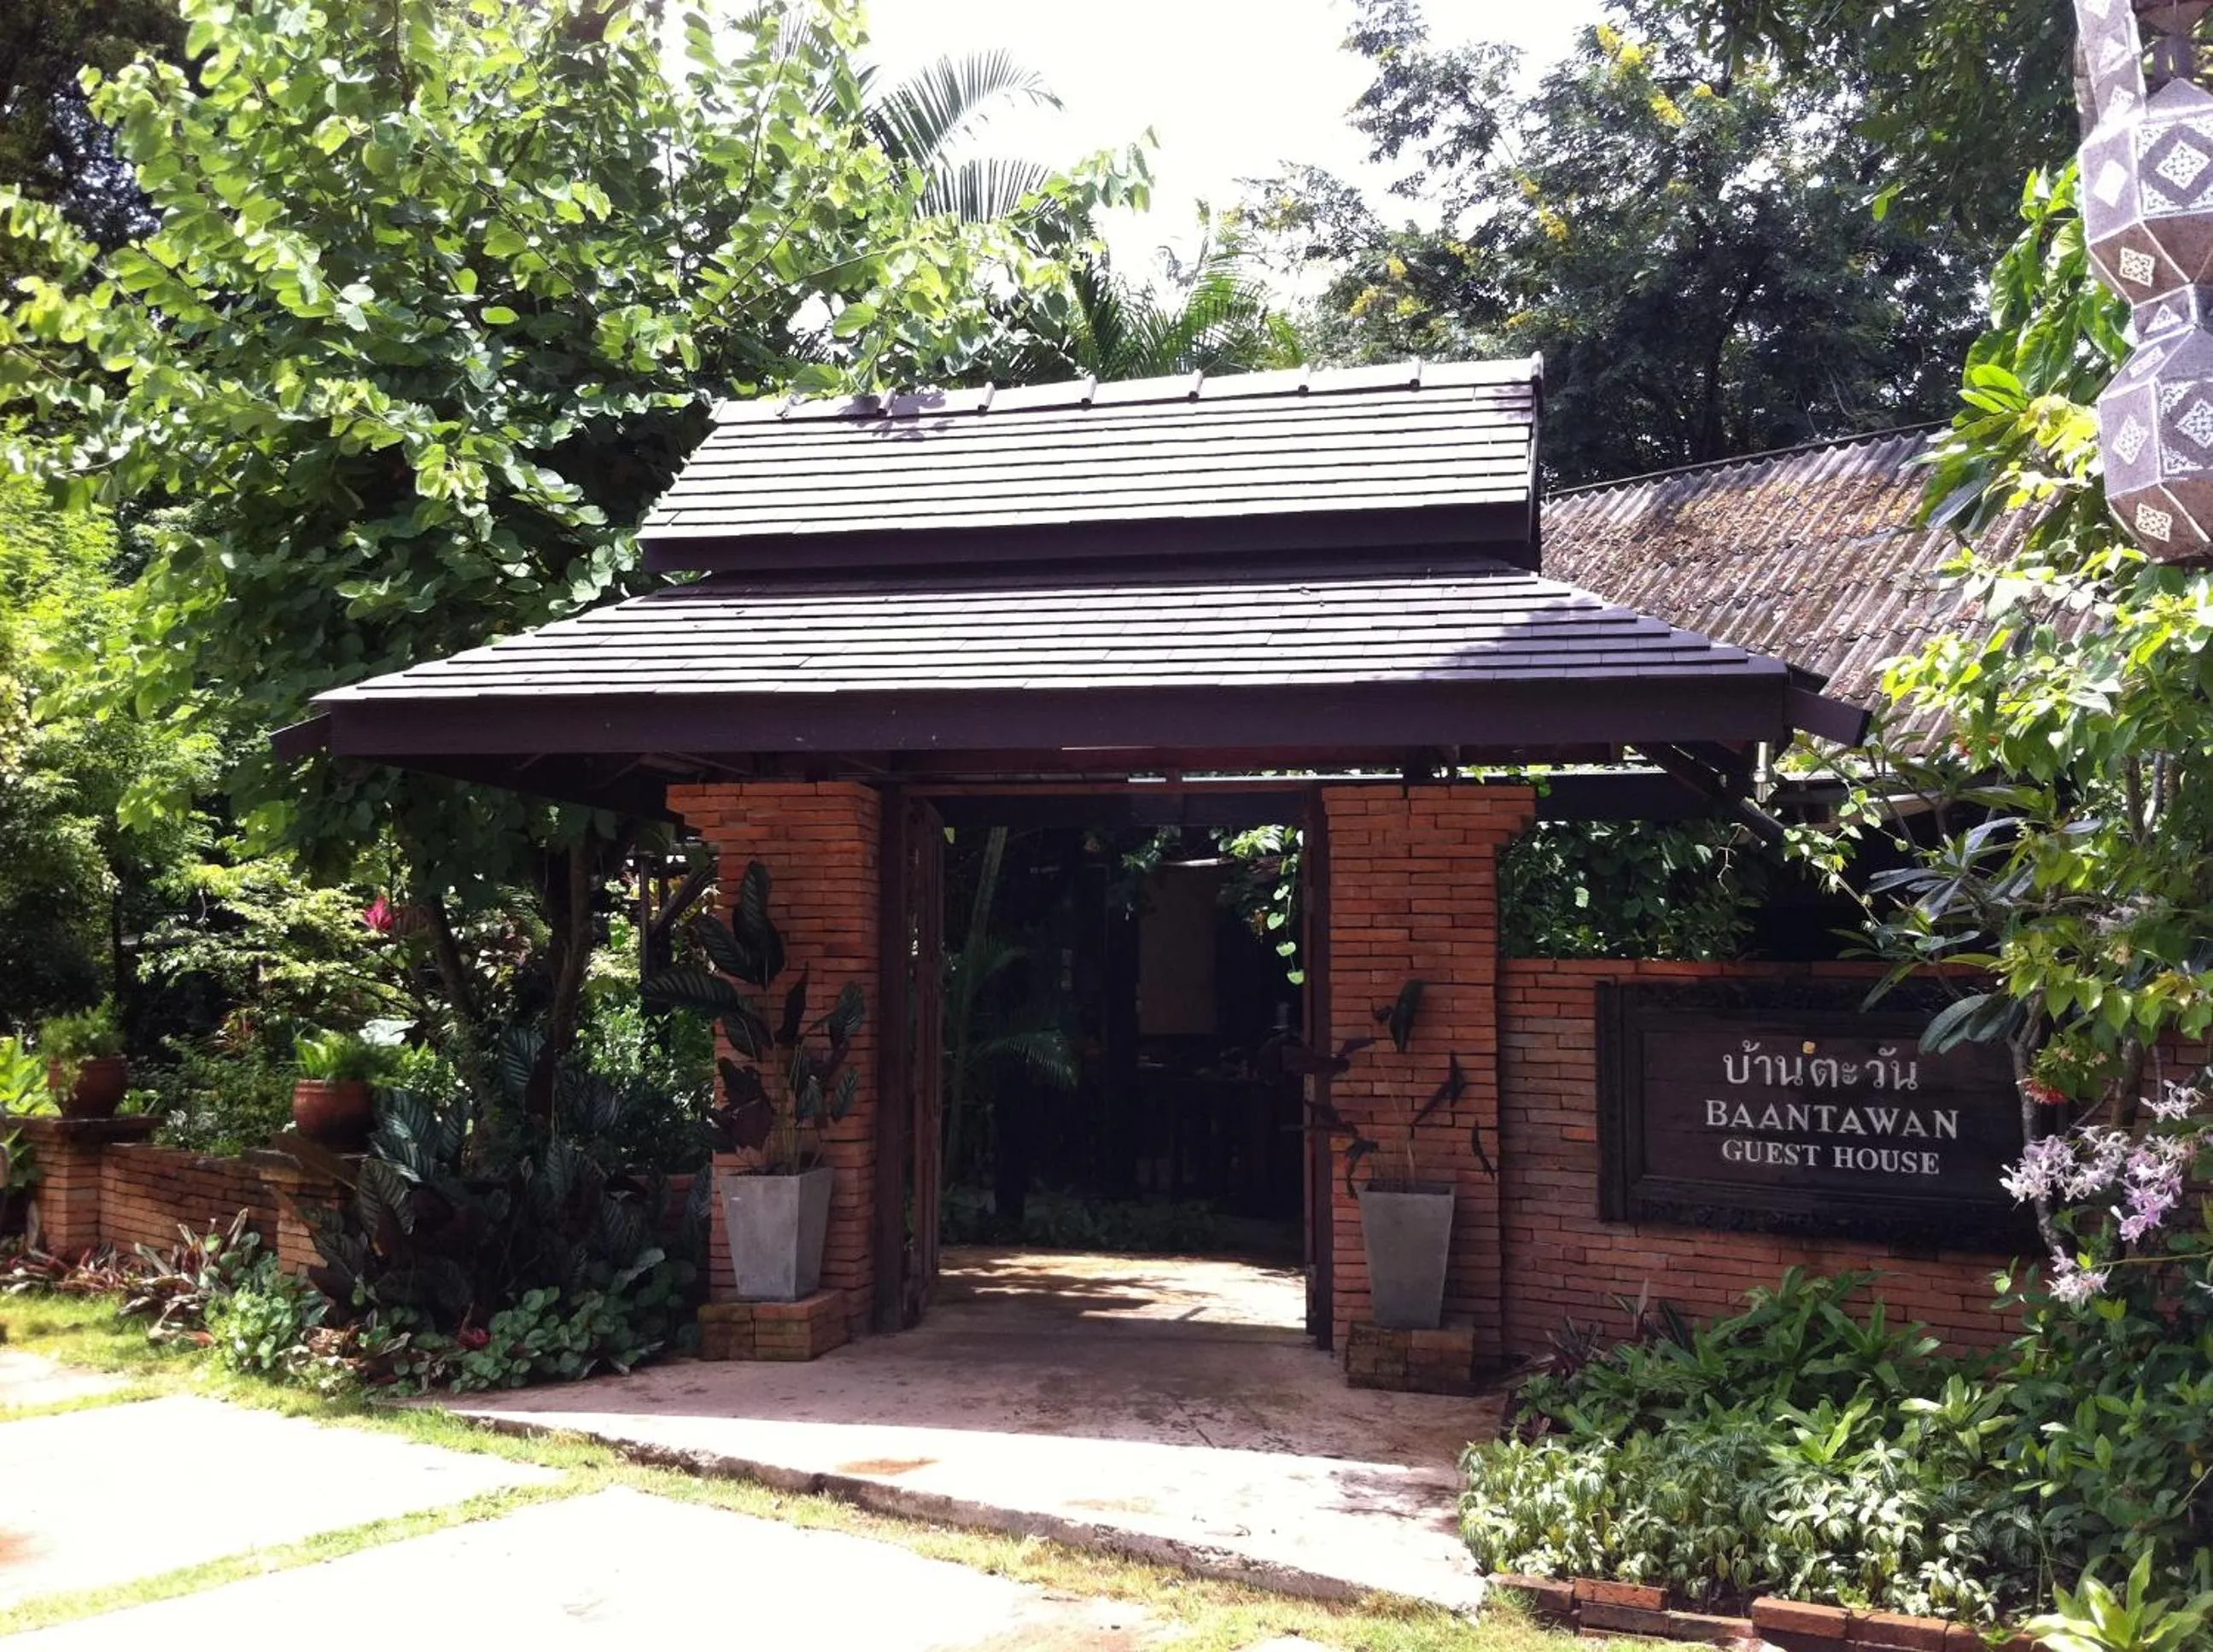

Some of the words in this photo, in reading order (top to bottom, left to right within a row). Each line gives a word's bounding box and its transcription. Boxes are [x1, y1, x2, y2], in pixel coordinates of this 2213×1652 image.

[1723, 1040, 1918, 1090] บ้านตะวัน
[1706, 1100, 1959, 1139] BAANTAWAN
[1722, 1140, 1820, 1167] GUEST
[1831, 1146, 1940, 1175] HOUSE
